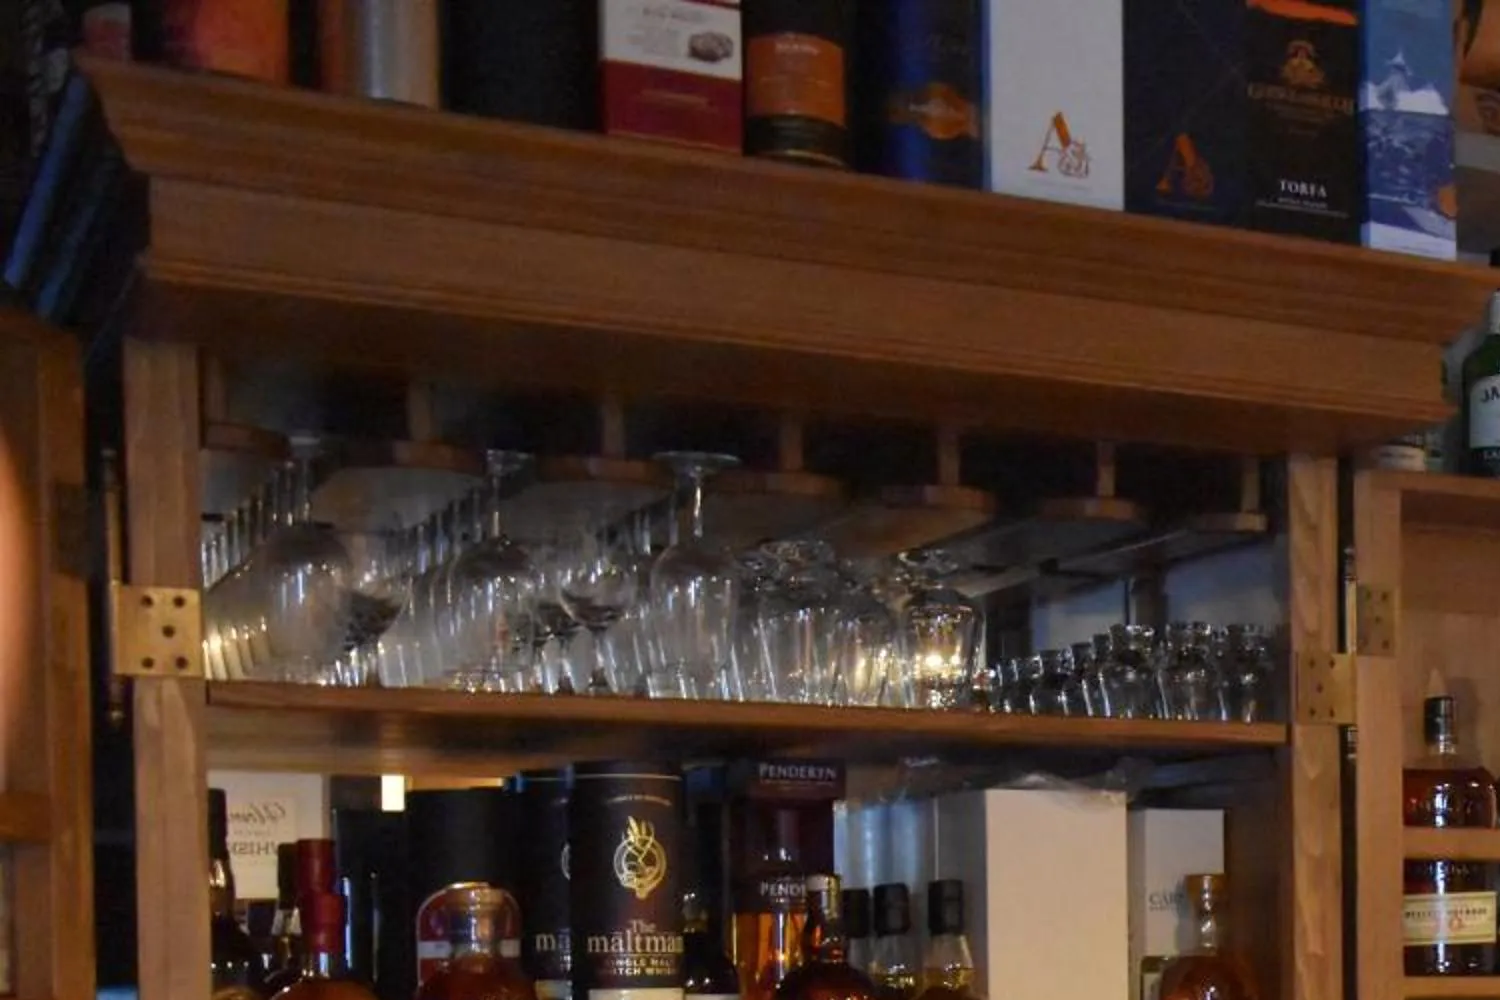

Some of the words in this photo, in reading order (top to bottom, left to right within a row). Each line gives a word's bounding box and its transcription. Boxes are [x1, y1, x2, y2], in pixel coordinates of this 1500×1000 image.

[759, 762, 838, 781] PENDERYN
[630, 919, 658, 933] The
[588, 929, 684, 954] maltma
